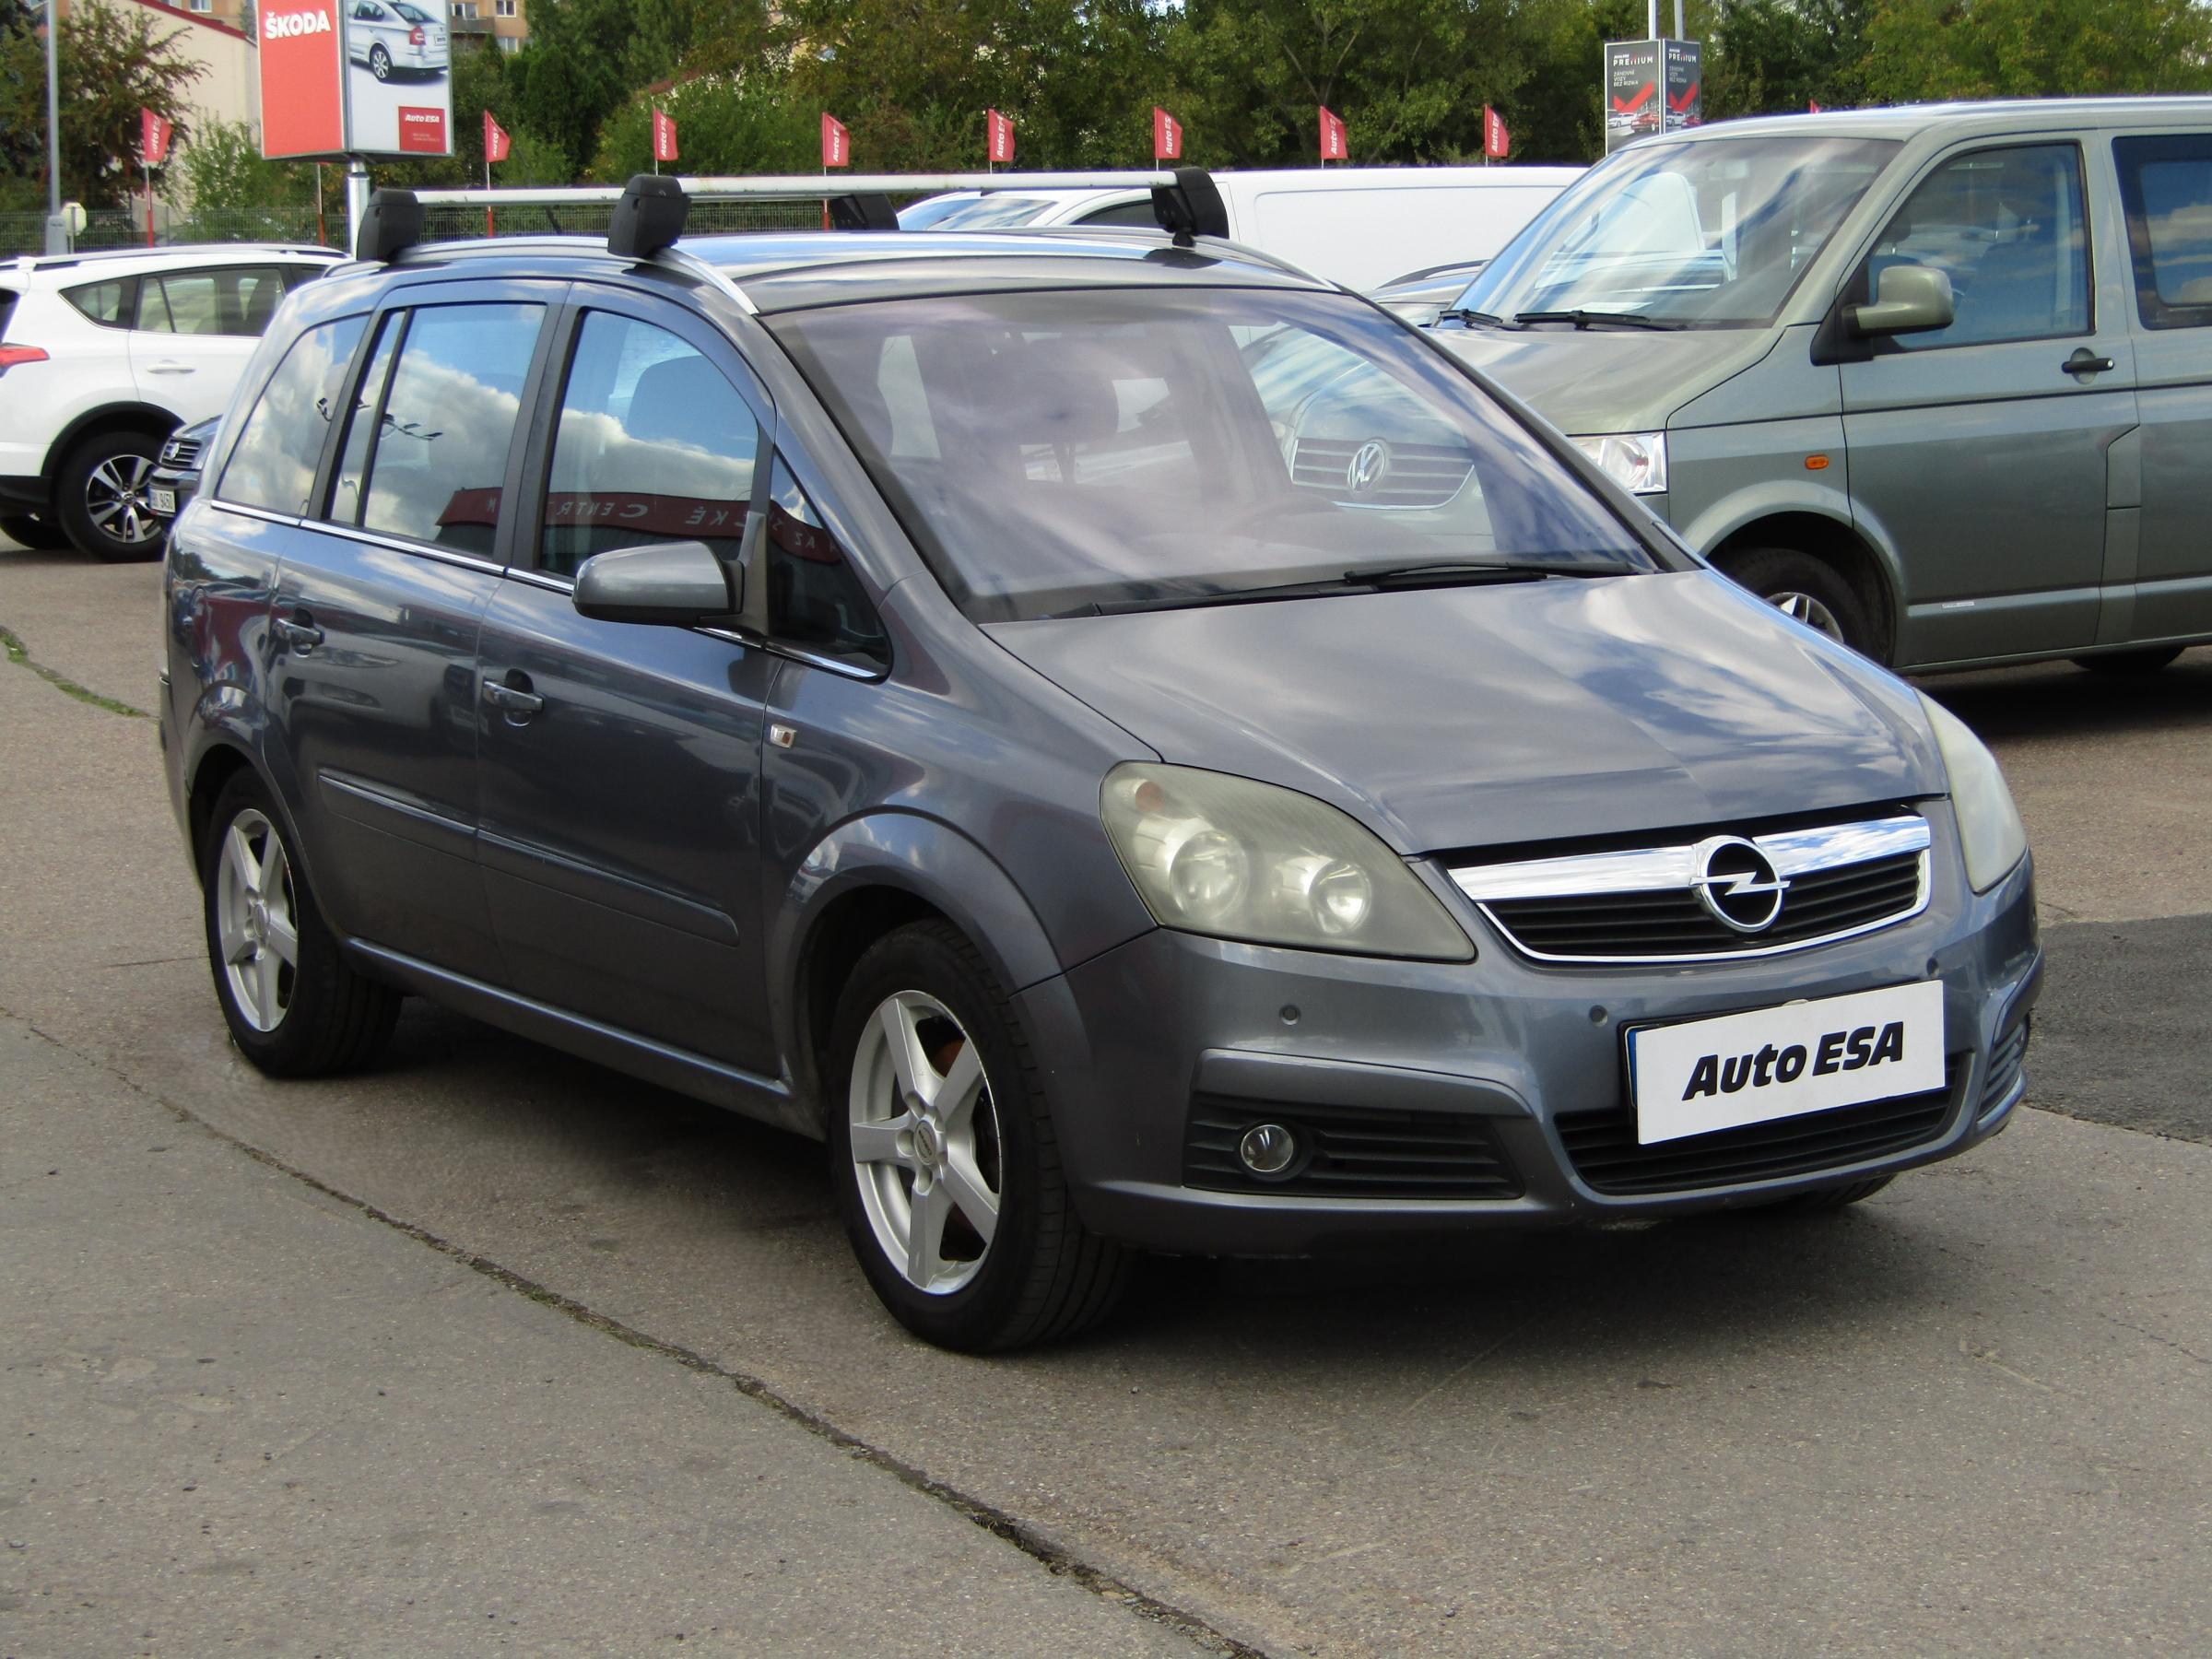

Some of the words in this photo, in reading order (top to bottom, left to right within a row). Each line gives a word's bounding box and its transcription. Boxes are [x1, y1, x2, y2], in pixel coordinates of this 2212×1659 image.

[265, 10, 331, 39] ŠKODA
[406, 113, 425, 123] Auto
[425, 115, 440, 124] ESA
[996, 133, 1005, 158] Auto
[1165, 130, 1173, 155] Auto
[1681, 1043, 1807, 1101] Auto
[1812, 1020, 1905, 1077] ESA
